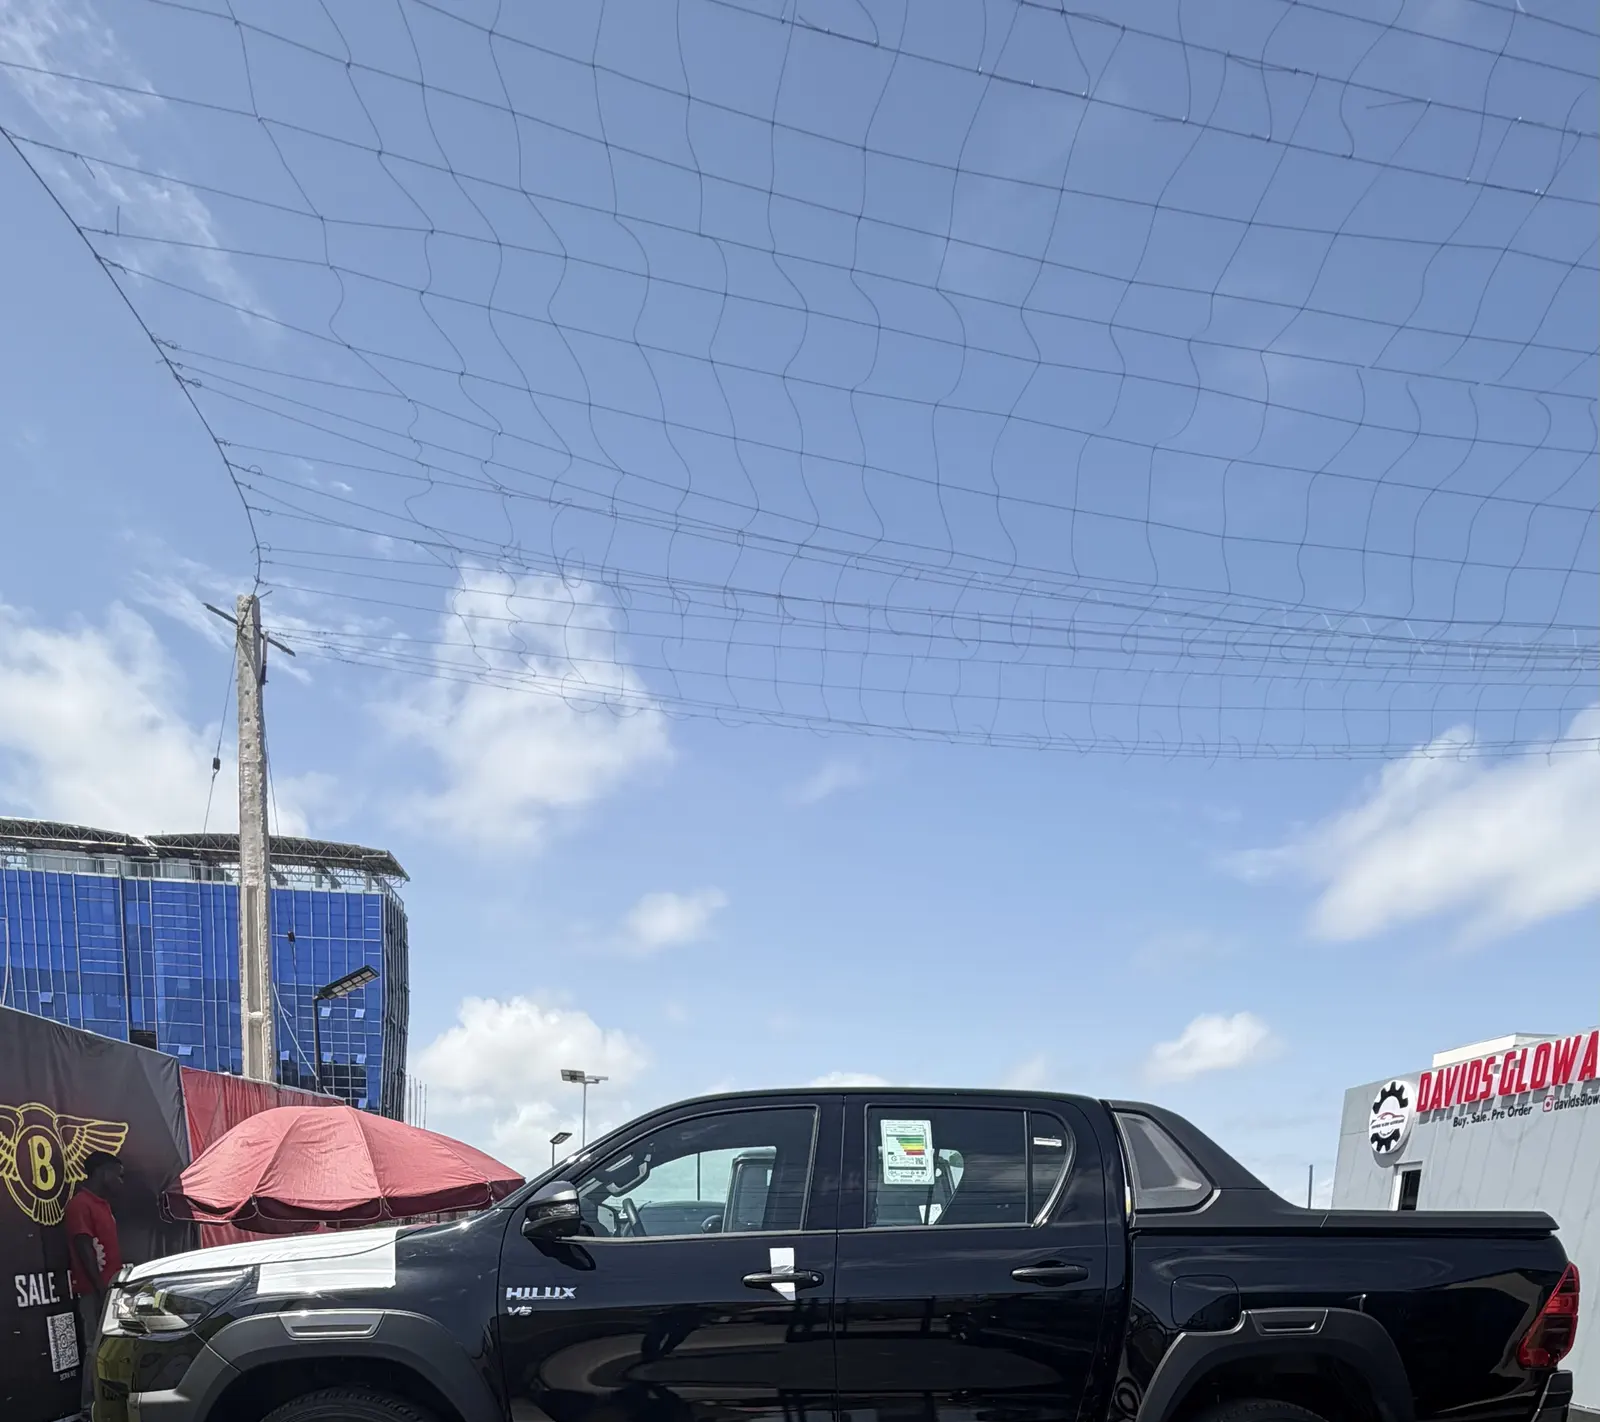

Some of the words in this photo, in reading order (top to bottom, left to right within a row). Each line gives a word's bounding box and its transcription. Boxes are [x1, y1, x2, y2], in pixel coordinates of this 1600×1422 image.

[1416, 1056, 1496, 1112] DAVIDS
[1498, 1035, 1582, 1096] GLOW
[1491, 1108, 1505, 1120] Pre
[1507, 1105, 1533, 1117] Order
[1554, 1093, 1600, 1110] davidsglow
[28, 1135, 56, 1191] B
[506, 1286, 577, 1300] HILUX
